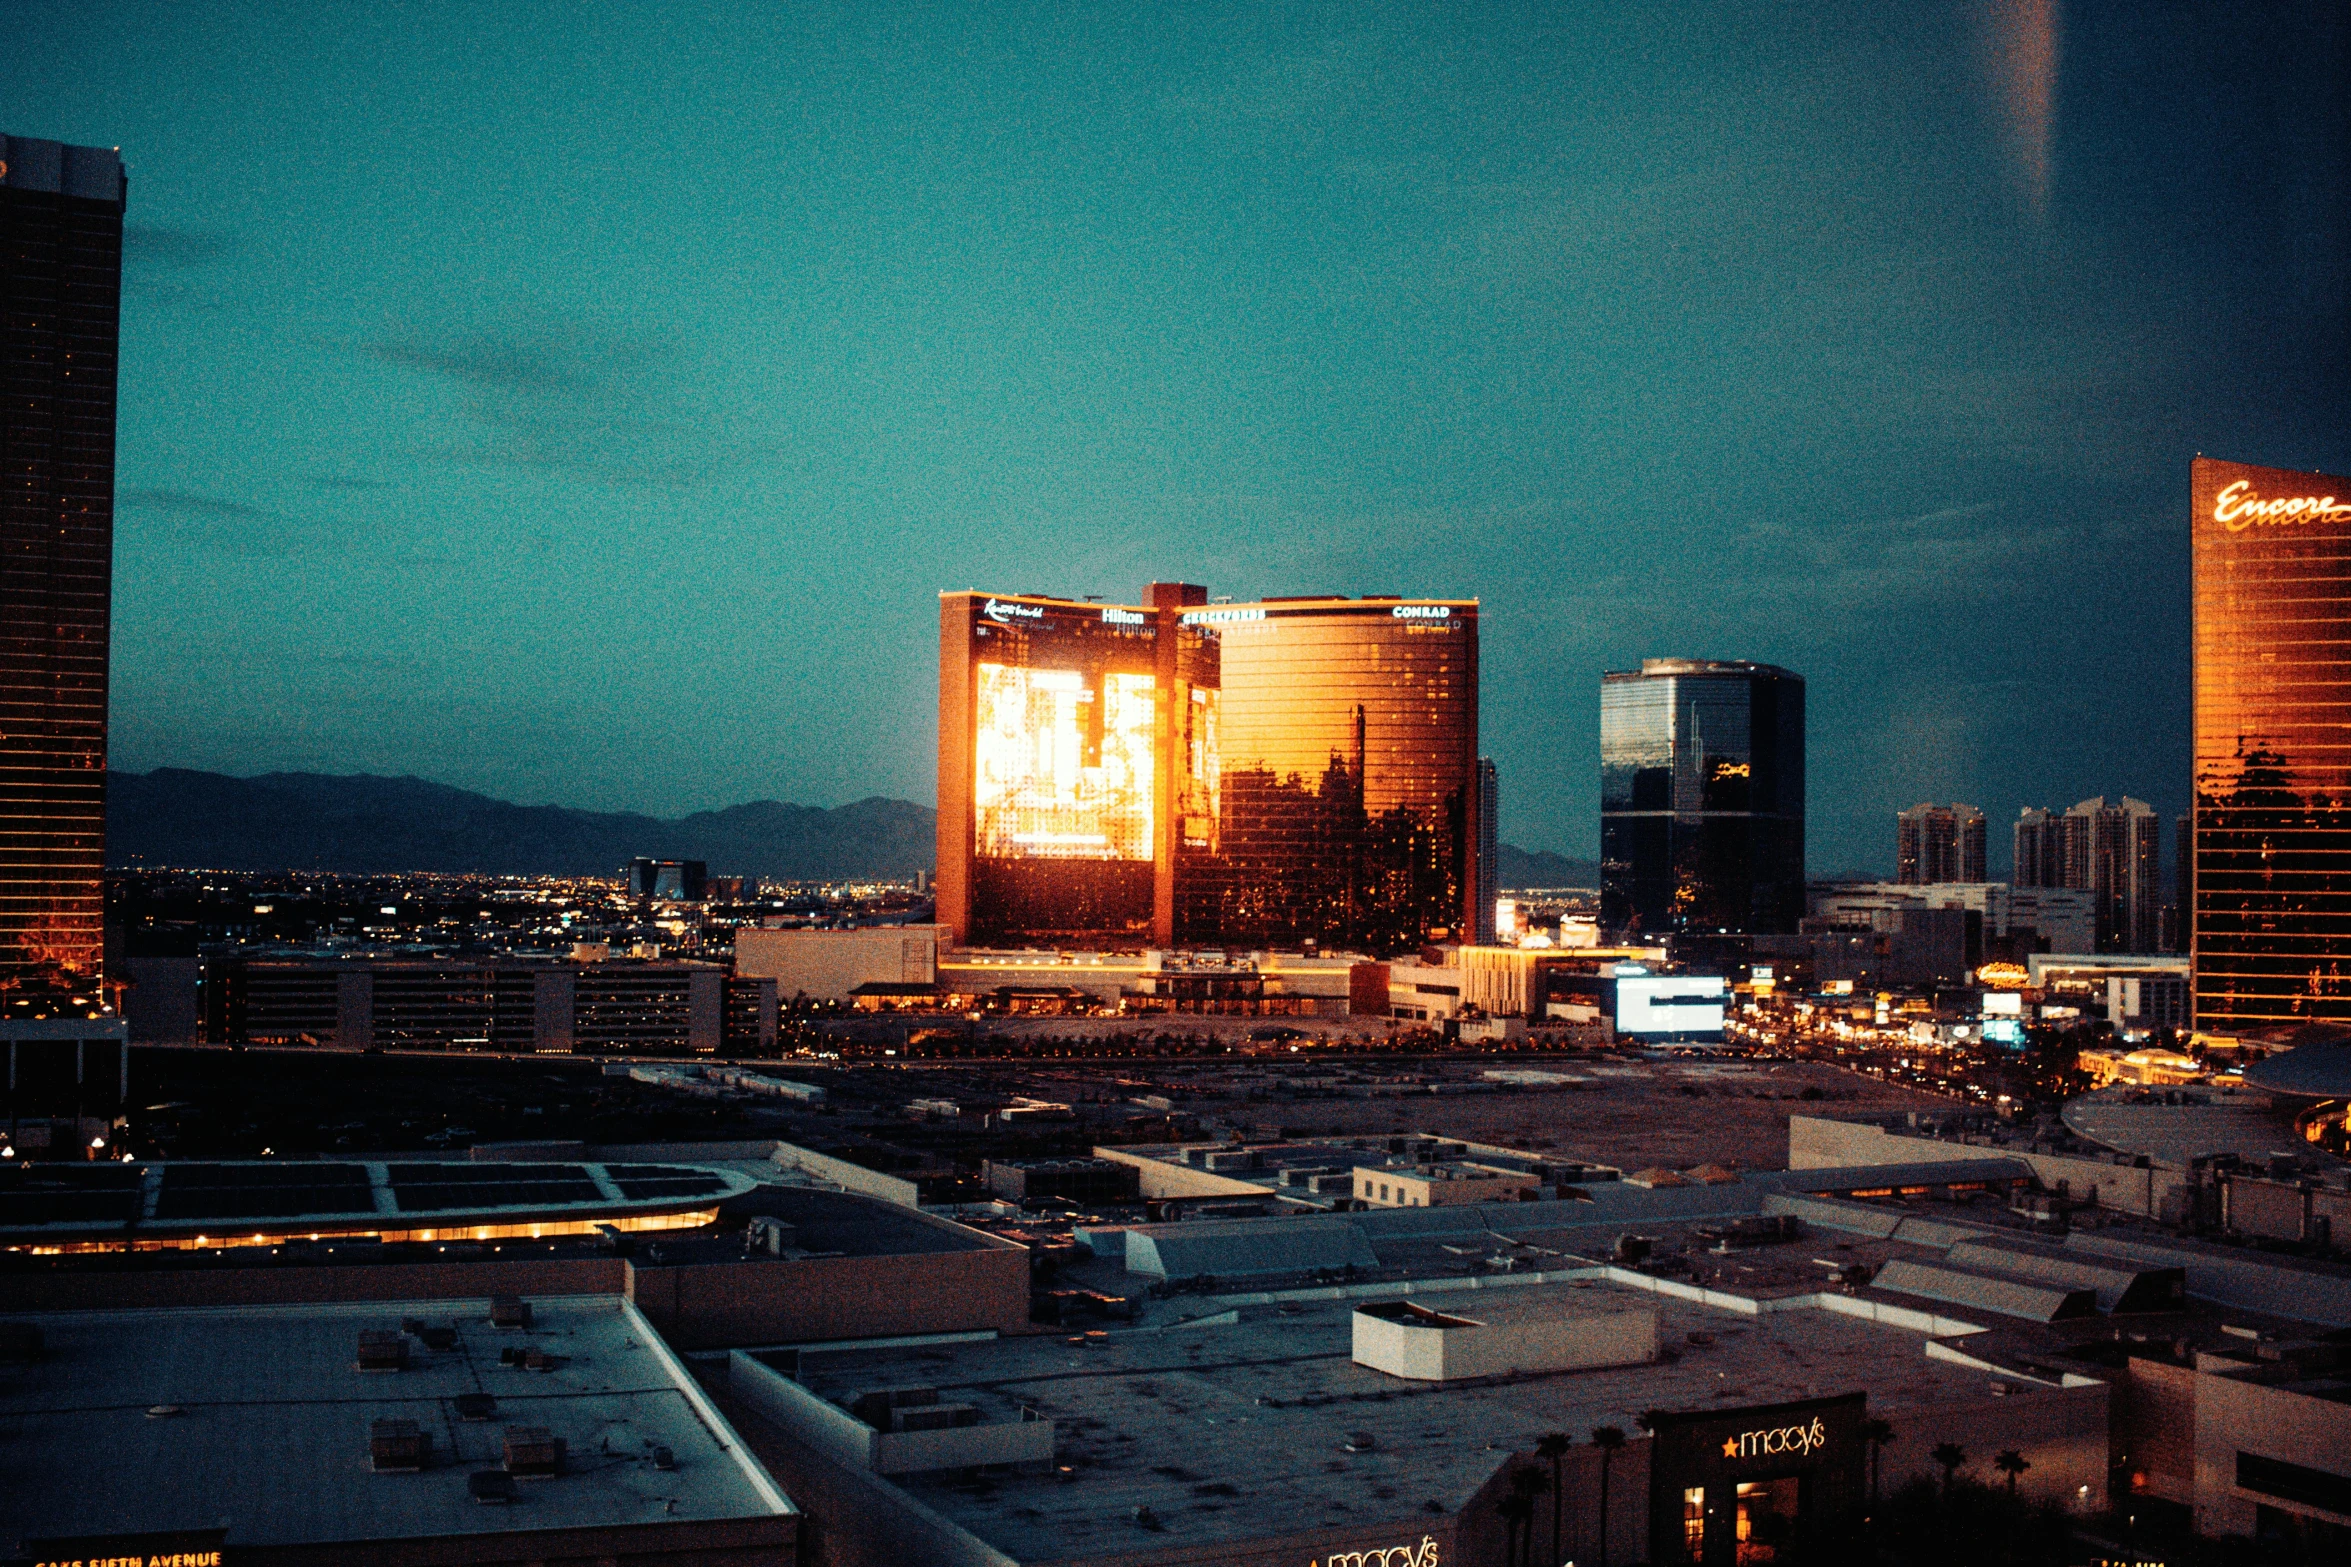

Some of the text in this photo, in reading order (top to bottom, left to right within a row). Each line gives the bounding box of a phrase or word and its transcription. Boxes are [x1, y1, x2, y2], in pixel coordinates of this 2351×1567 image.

[2213, 479, 2351, 523] Encore
[1102, 608, 1144, 624] Hilton
[1392, 606, 1450, 618] CONRAD
[1739, 1416, 1825, 1457] macy's
[148, 1551, 221, 1567] AVENUE
